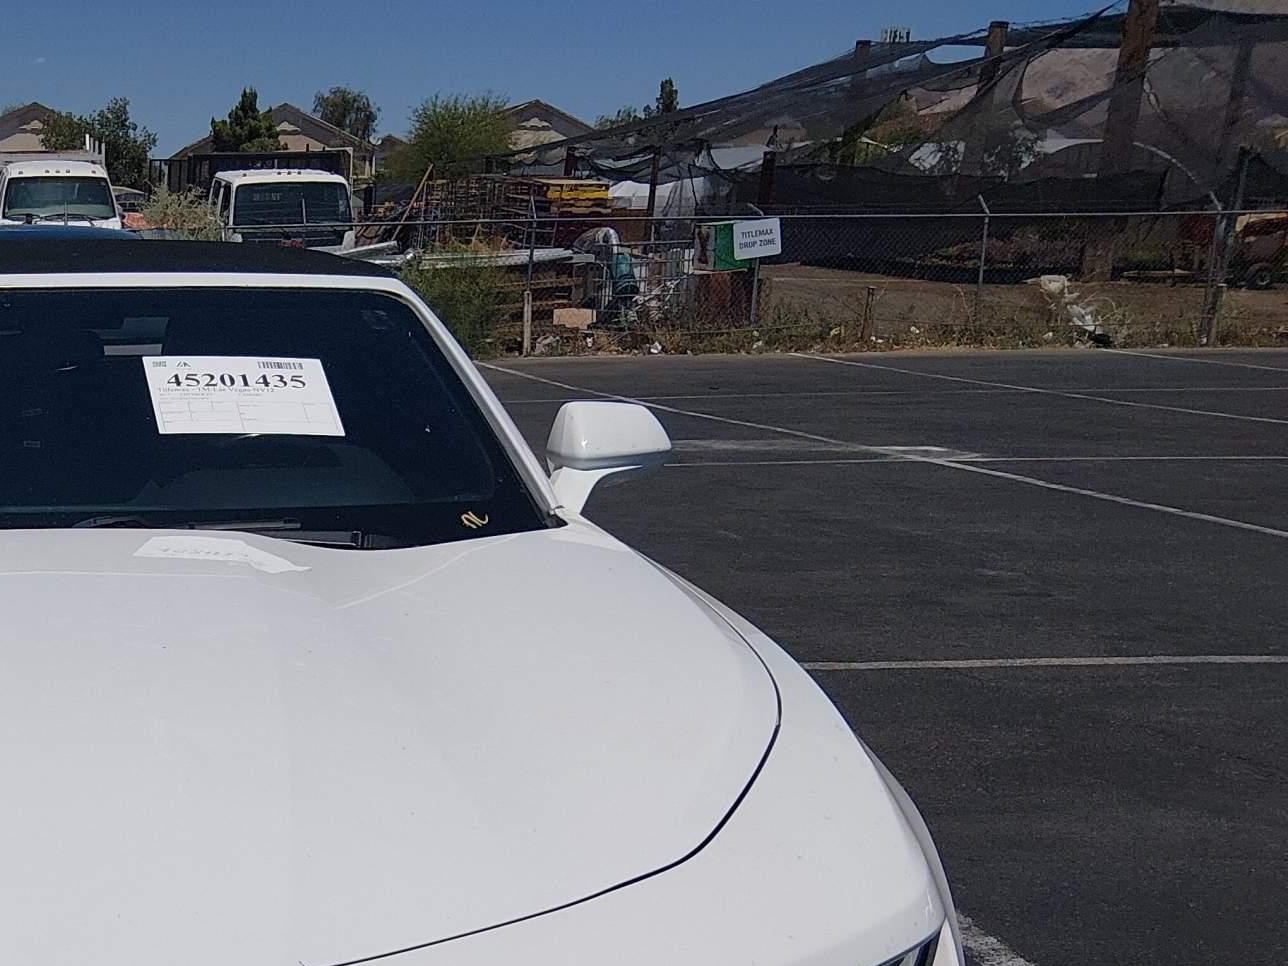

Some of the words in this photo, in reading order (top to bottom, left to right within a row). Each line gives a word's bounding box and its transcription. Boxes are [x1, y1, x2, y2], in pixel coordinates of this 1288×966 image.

[741, 229, 773, 239] TITLEMAX
[739, 241, 757, 250] DROP
[759, 238, 777, 247] ZONE
[167, 373, 306, 388] 45201435
